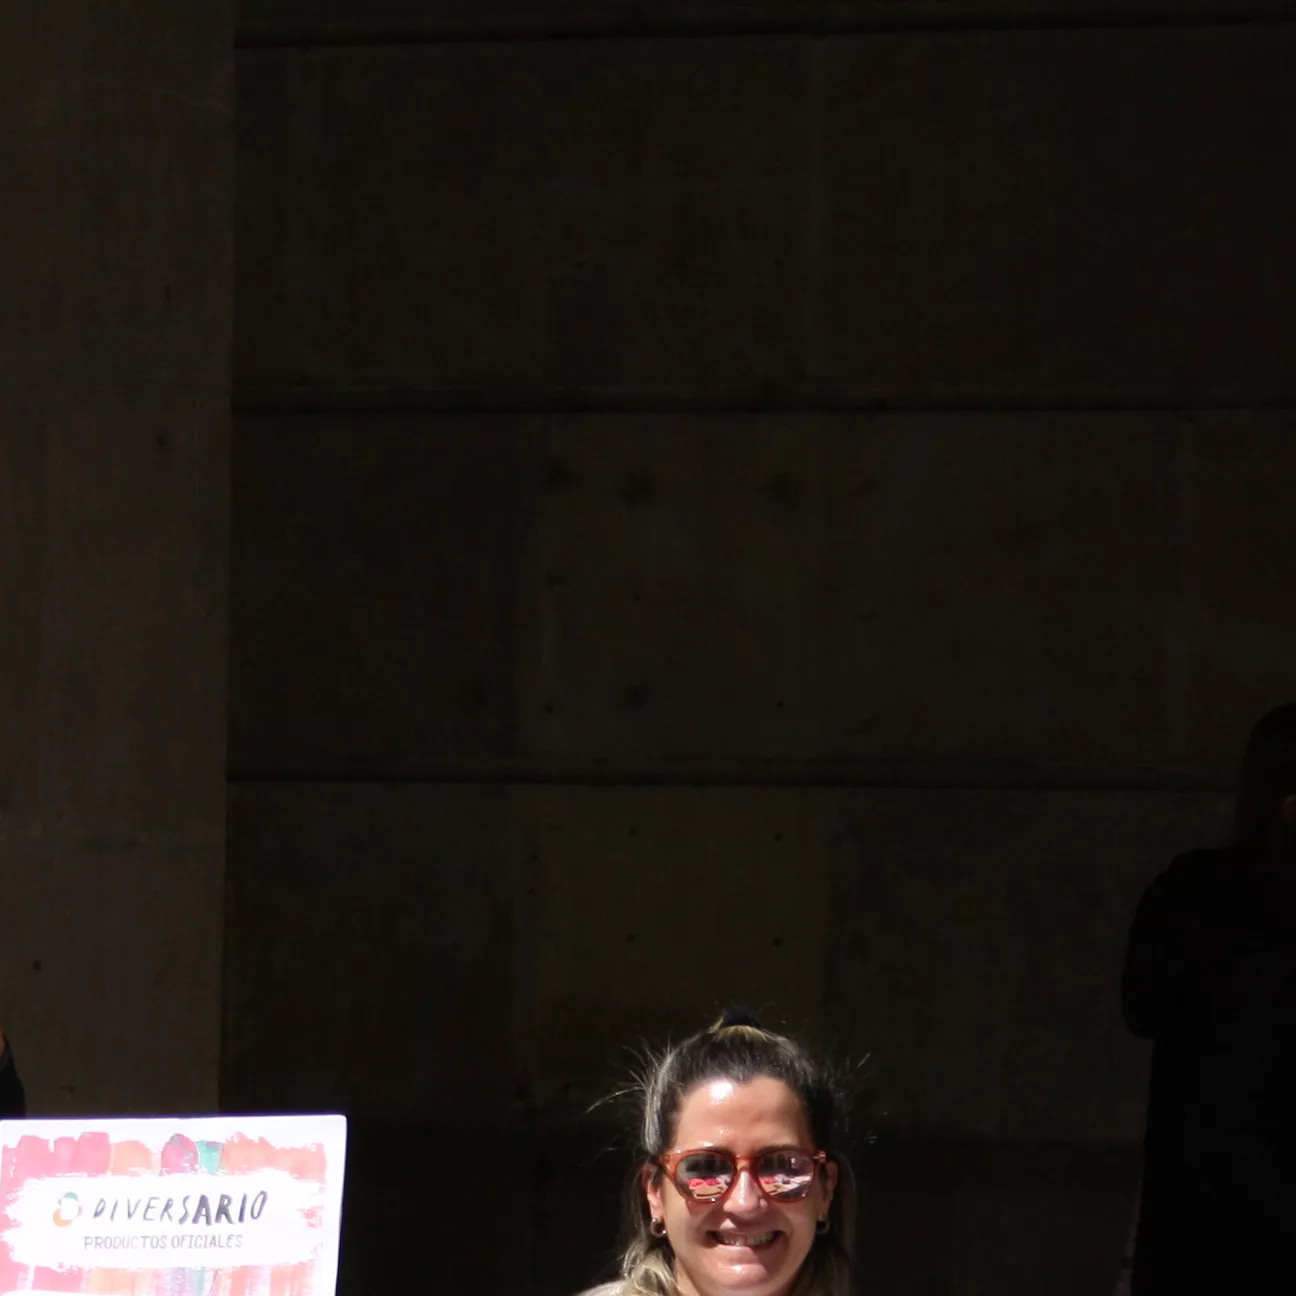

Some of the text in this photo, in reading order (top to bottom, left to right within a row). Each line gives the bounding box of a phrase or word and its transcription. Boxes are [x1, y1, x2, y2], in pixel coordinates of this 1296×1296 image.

[92, 1189, 270, 1226] DIVERSARIO
[83, 1233, 244, 1251] PRODUCTOS OFICIALES
